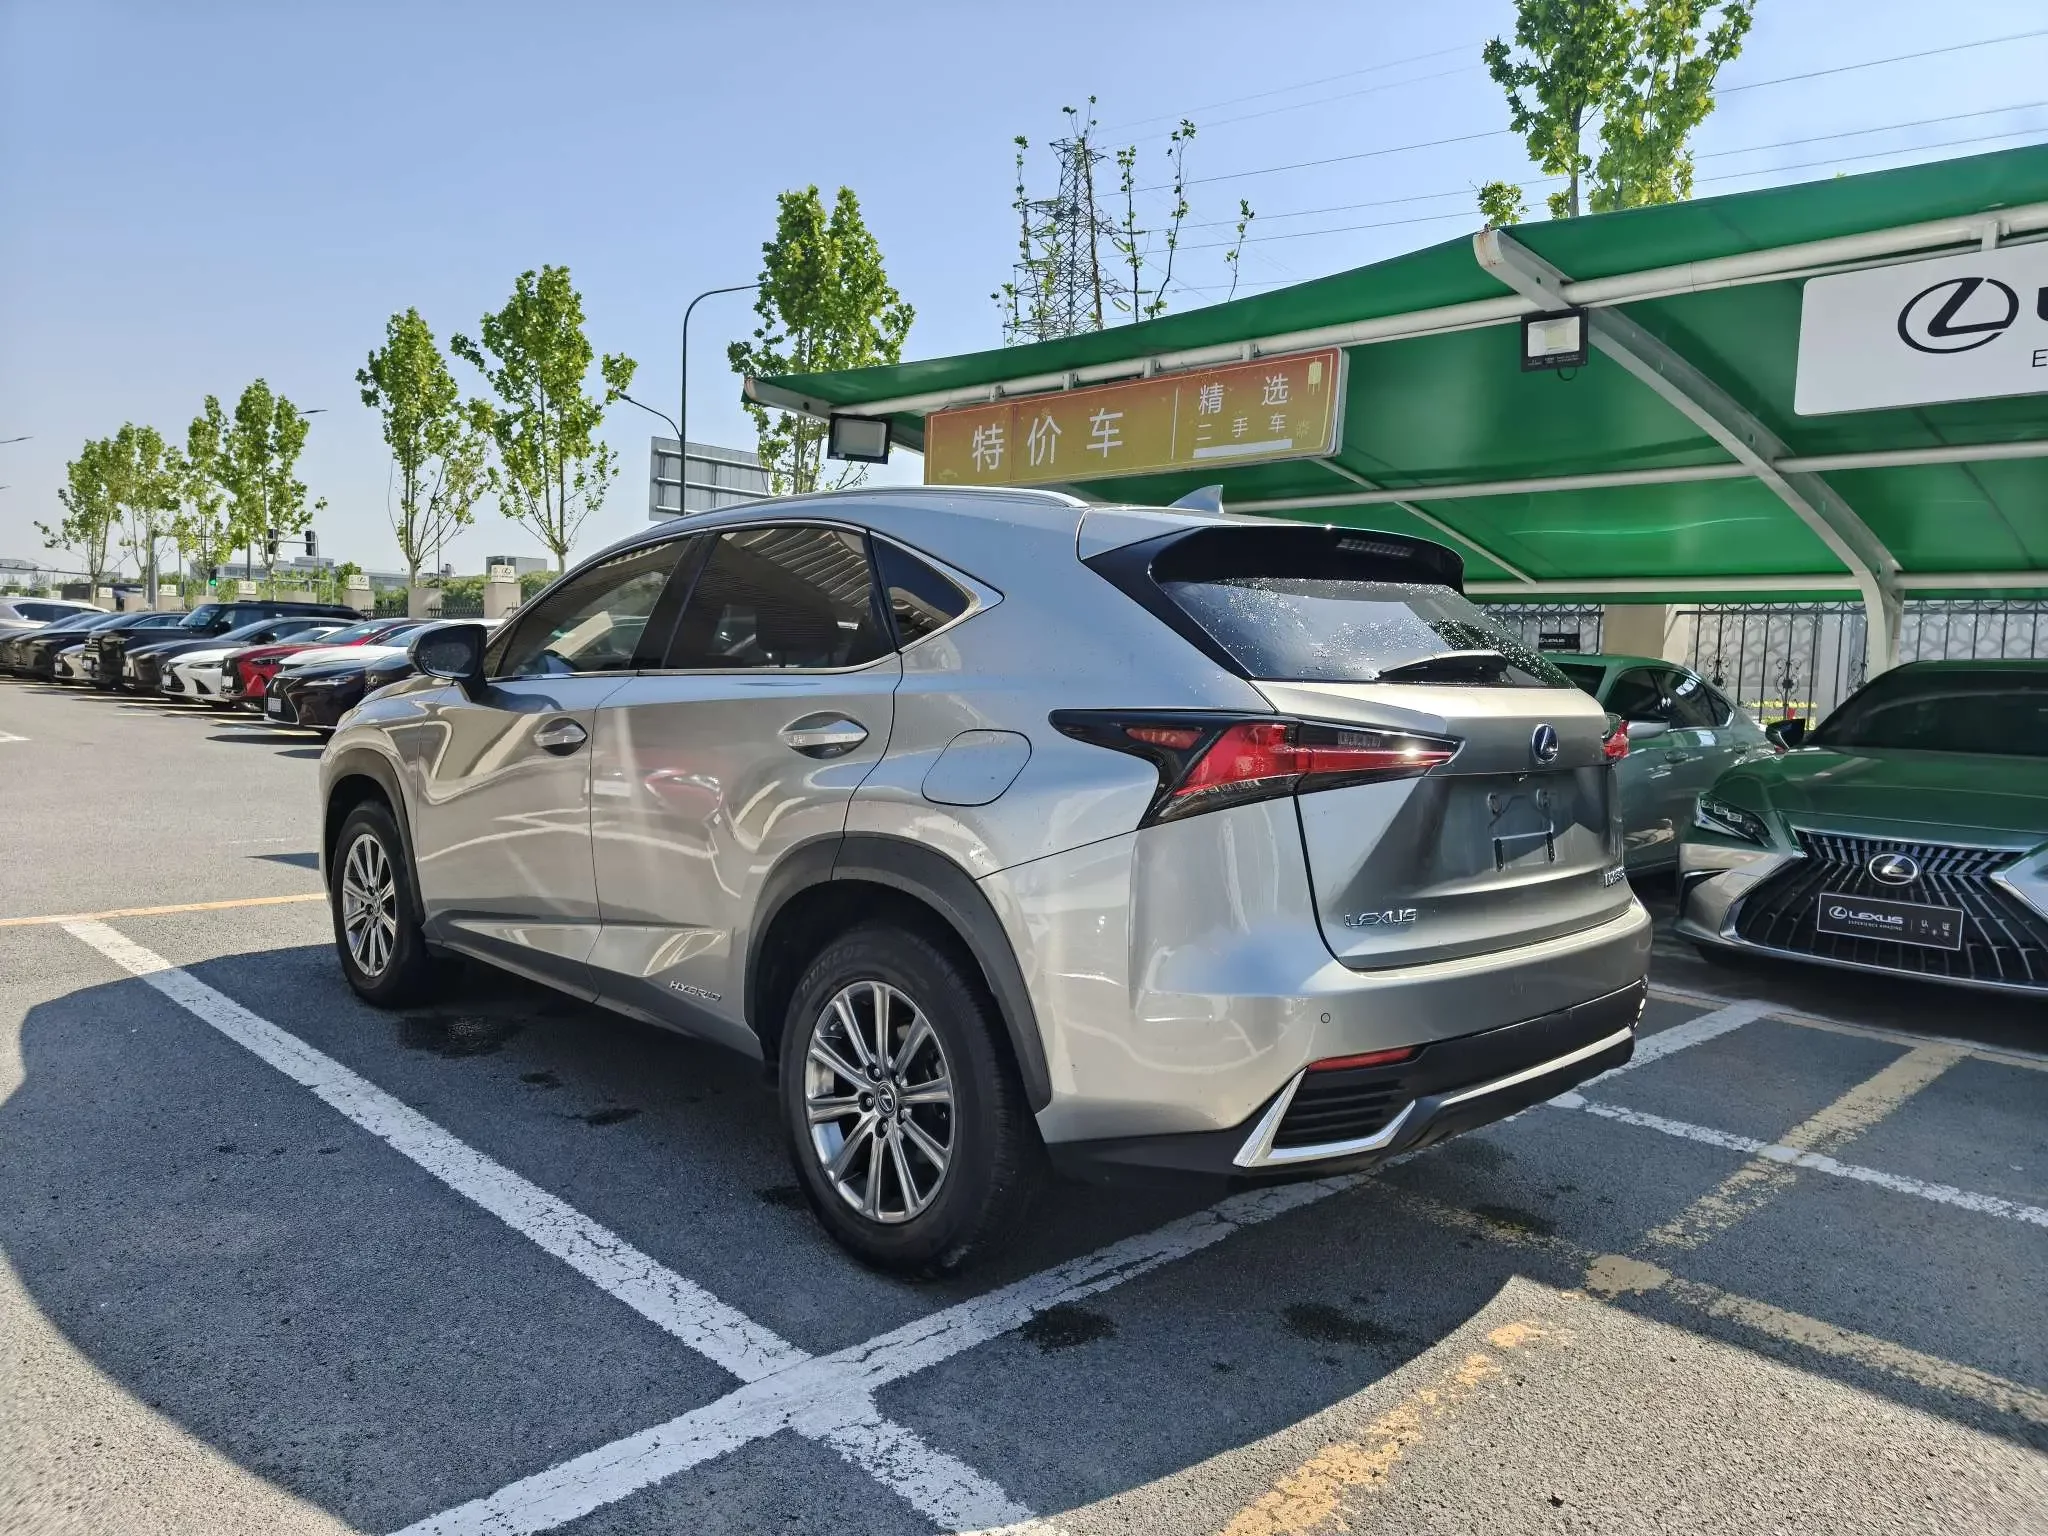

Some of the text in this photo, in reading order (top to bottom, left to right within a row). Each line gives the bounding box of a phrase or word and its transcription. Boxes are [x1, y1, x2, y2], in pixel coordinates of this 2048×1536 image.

[1198, 373, 1289, 415] 精选
[1196, 412, 1287, 440] 二手车
[971, 407, 1124, 473] 特价车
[1344, 908, 1417, 927] LEXUS
[1848, 910, 1904, 925] LEXUS
[669, 980, 721, 1001] HYBRID
